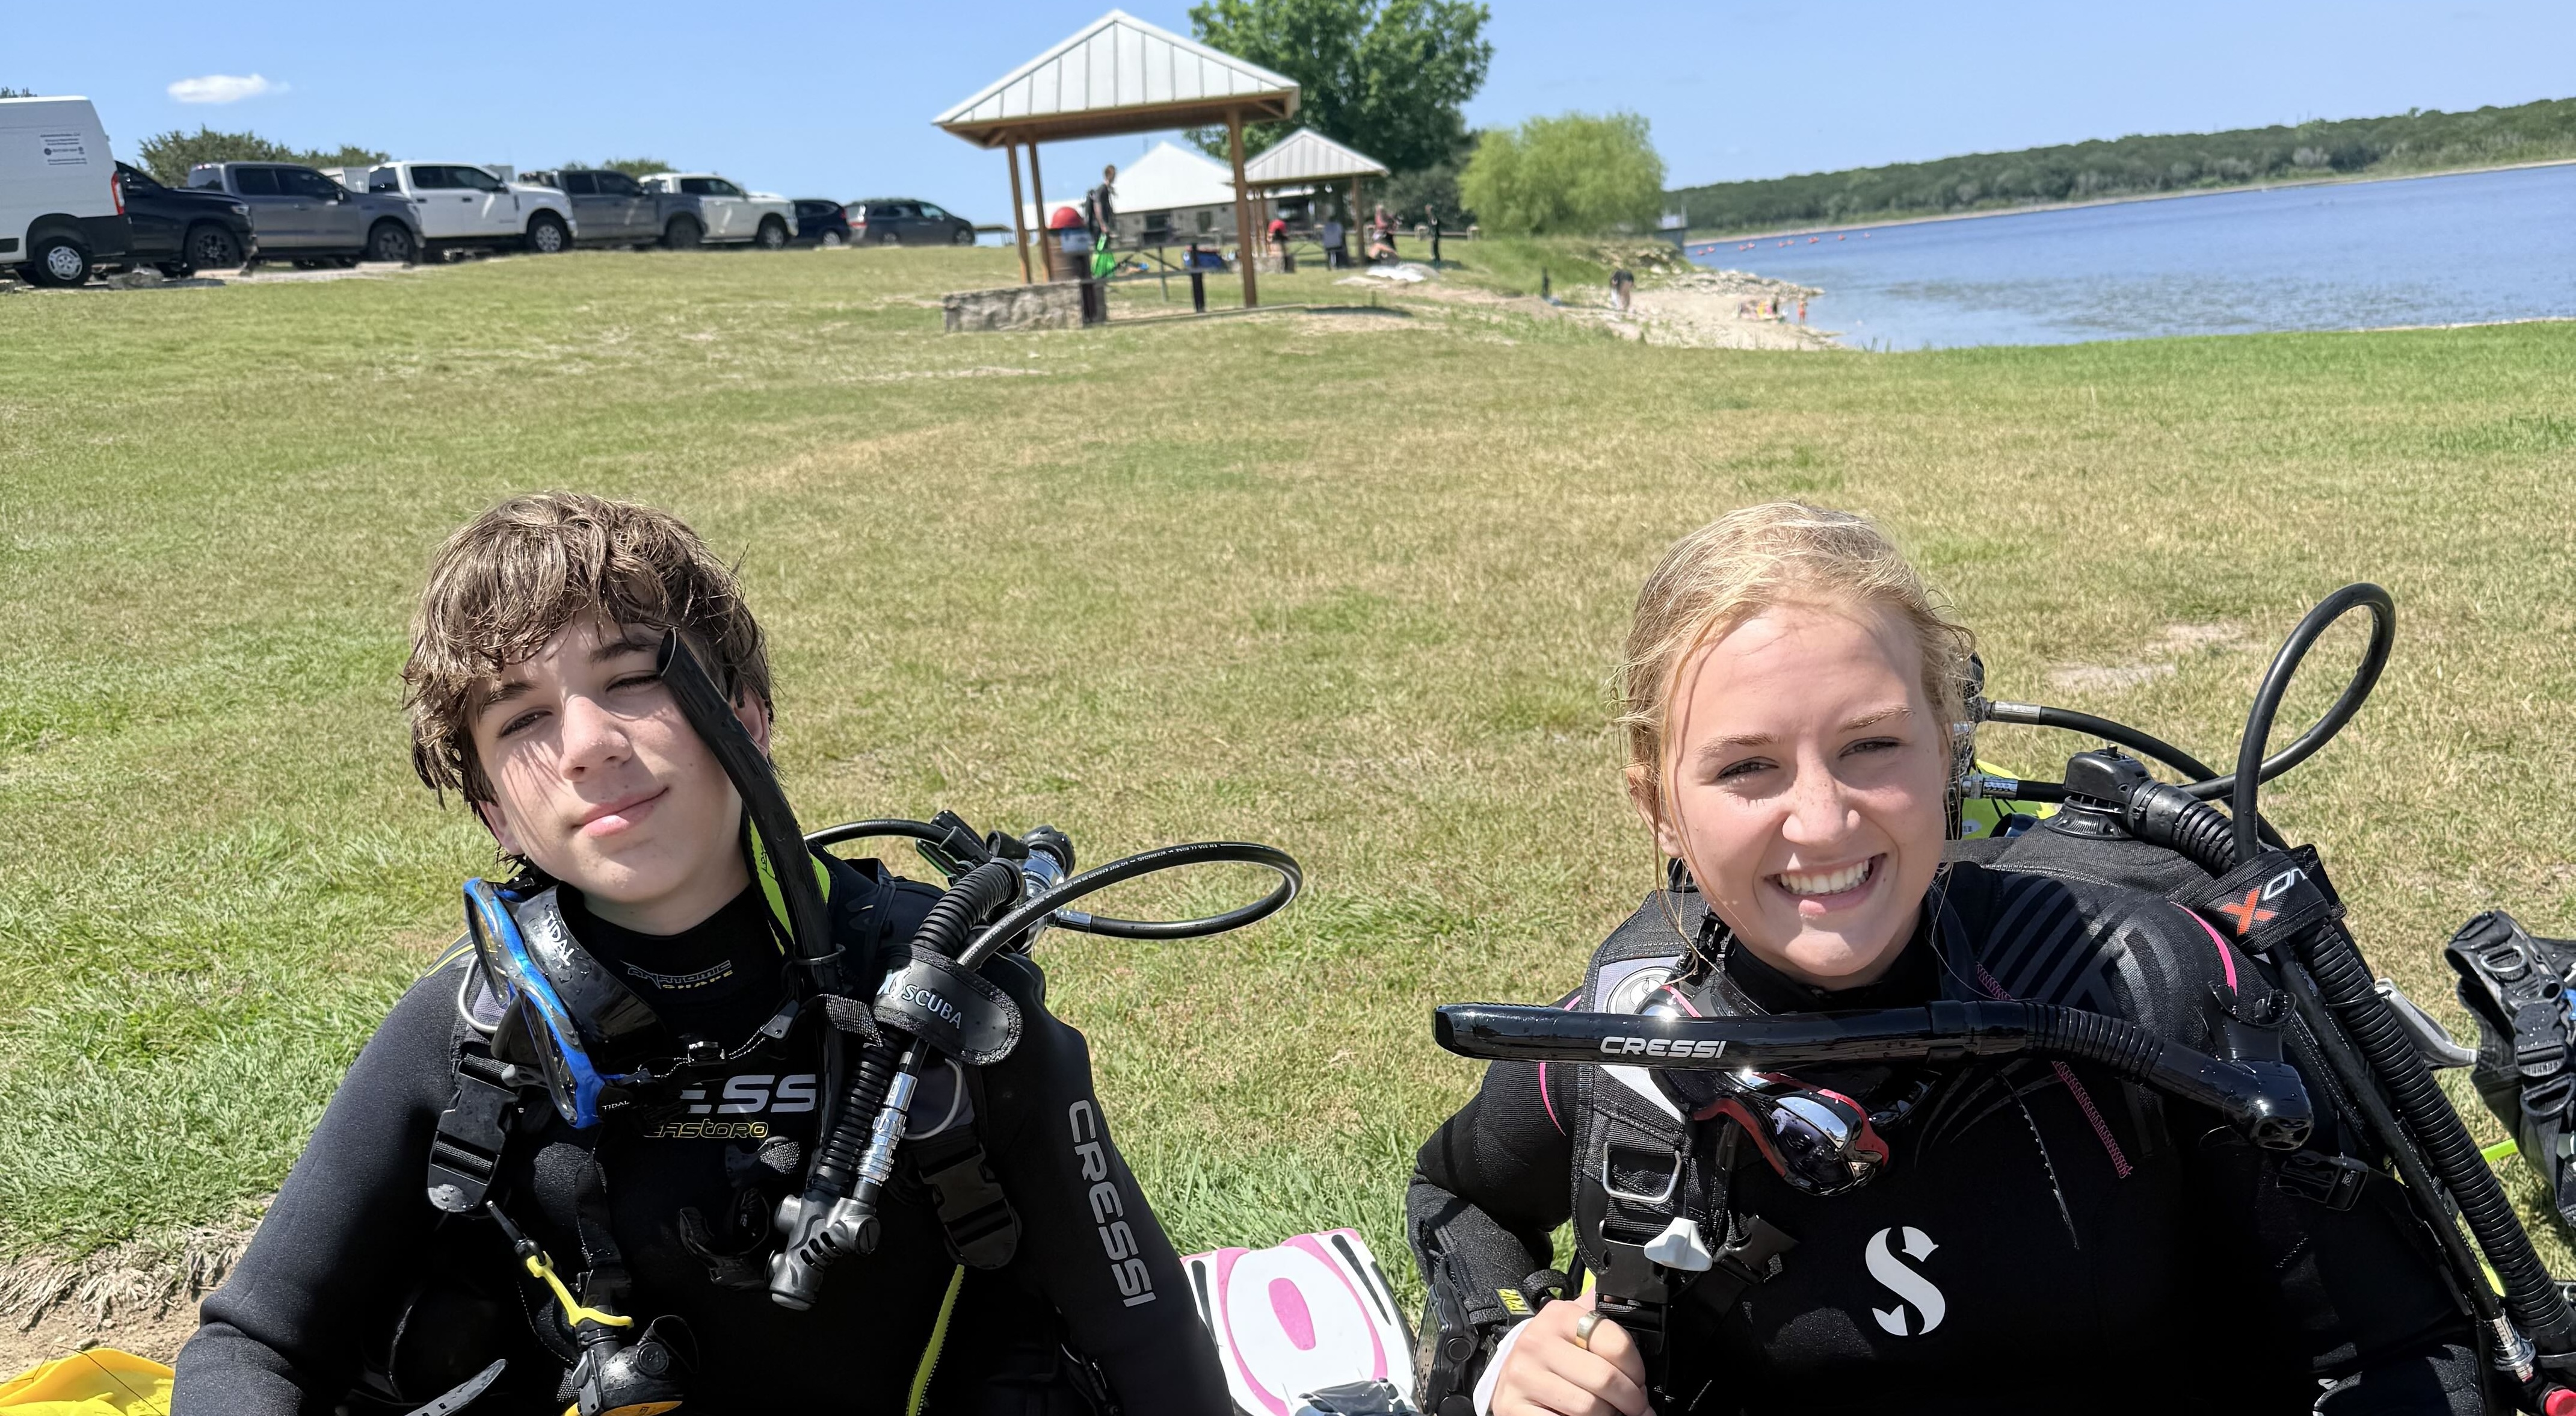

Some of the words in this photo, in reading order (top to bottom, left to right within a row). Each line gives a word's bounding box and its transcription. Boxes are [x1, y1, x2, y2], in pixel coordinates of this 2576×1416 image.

[541, 910, 575, 966] TIDAL
[902, 984, 962, 1030] SCUBA
[1600, 1036, 1727, 1059] CRESSI
[602, 1101, 630, 1110] TIDAL
[1069, 1099, 1156, 1307] CRESSI
